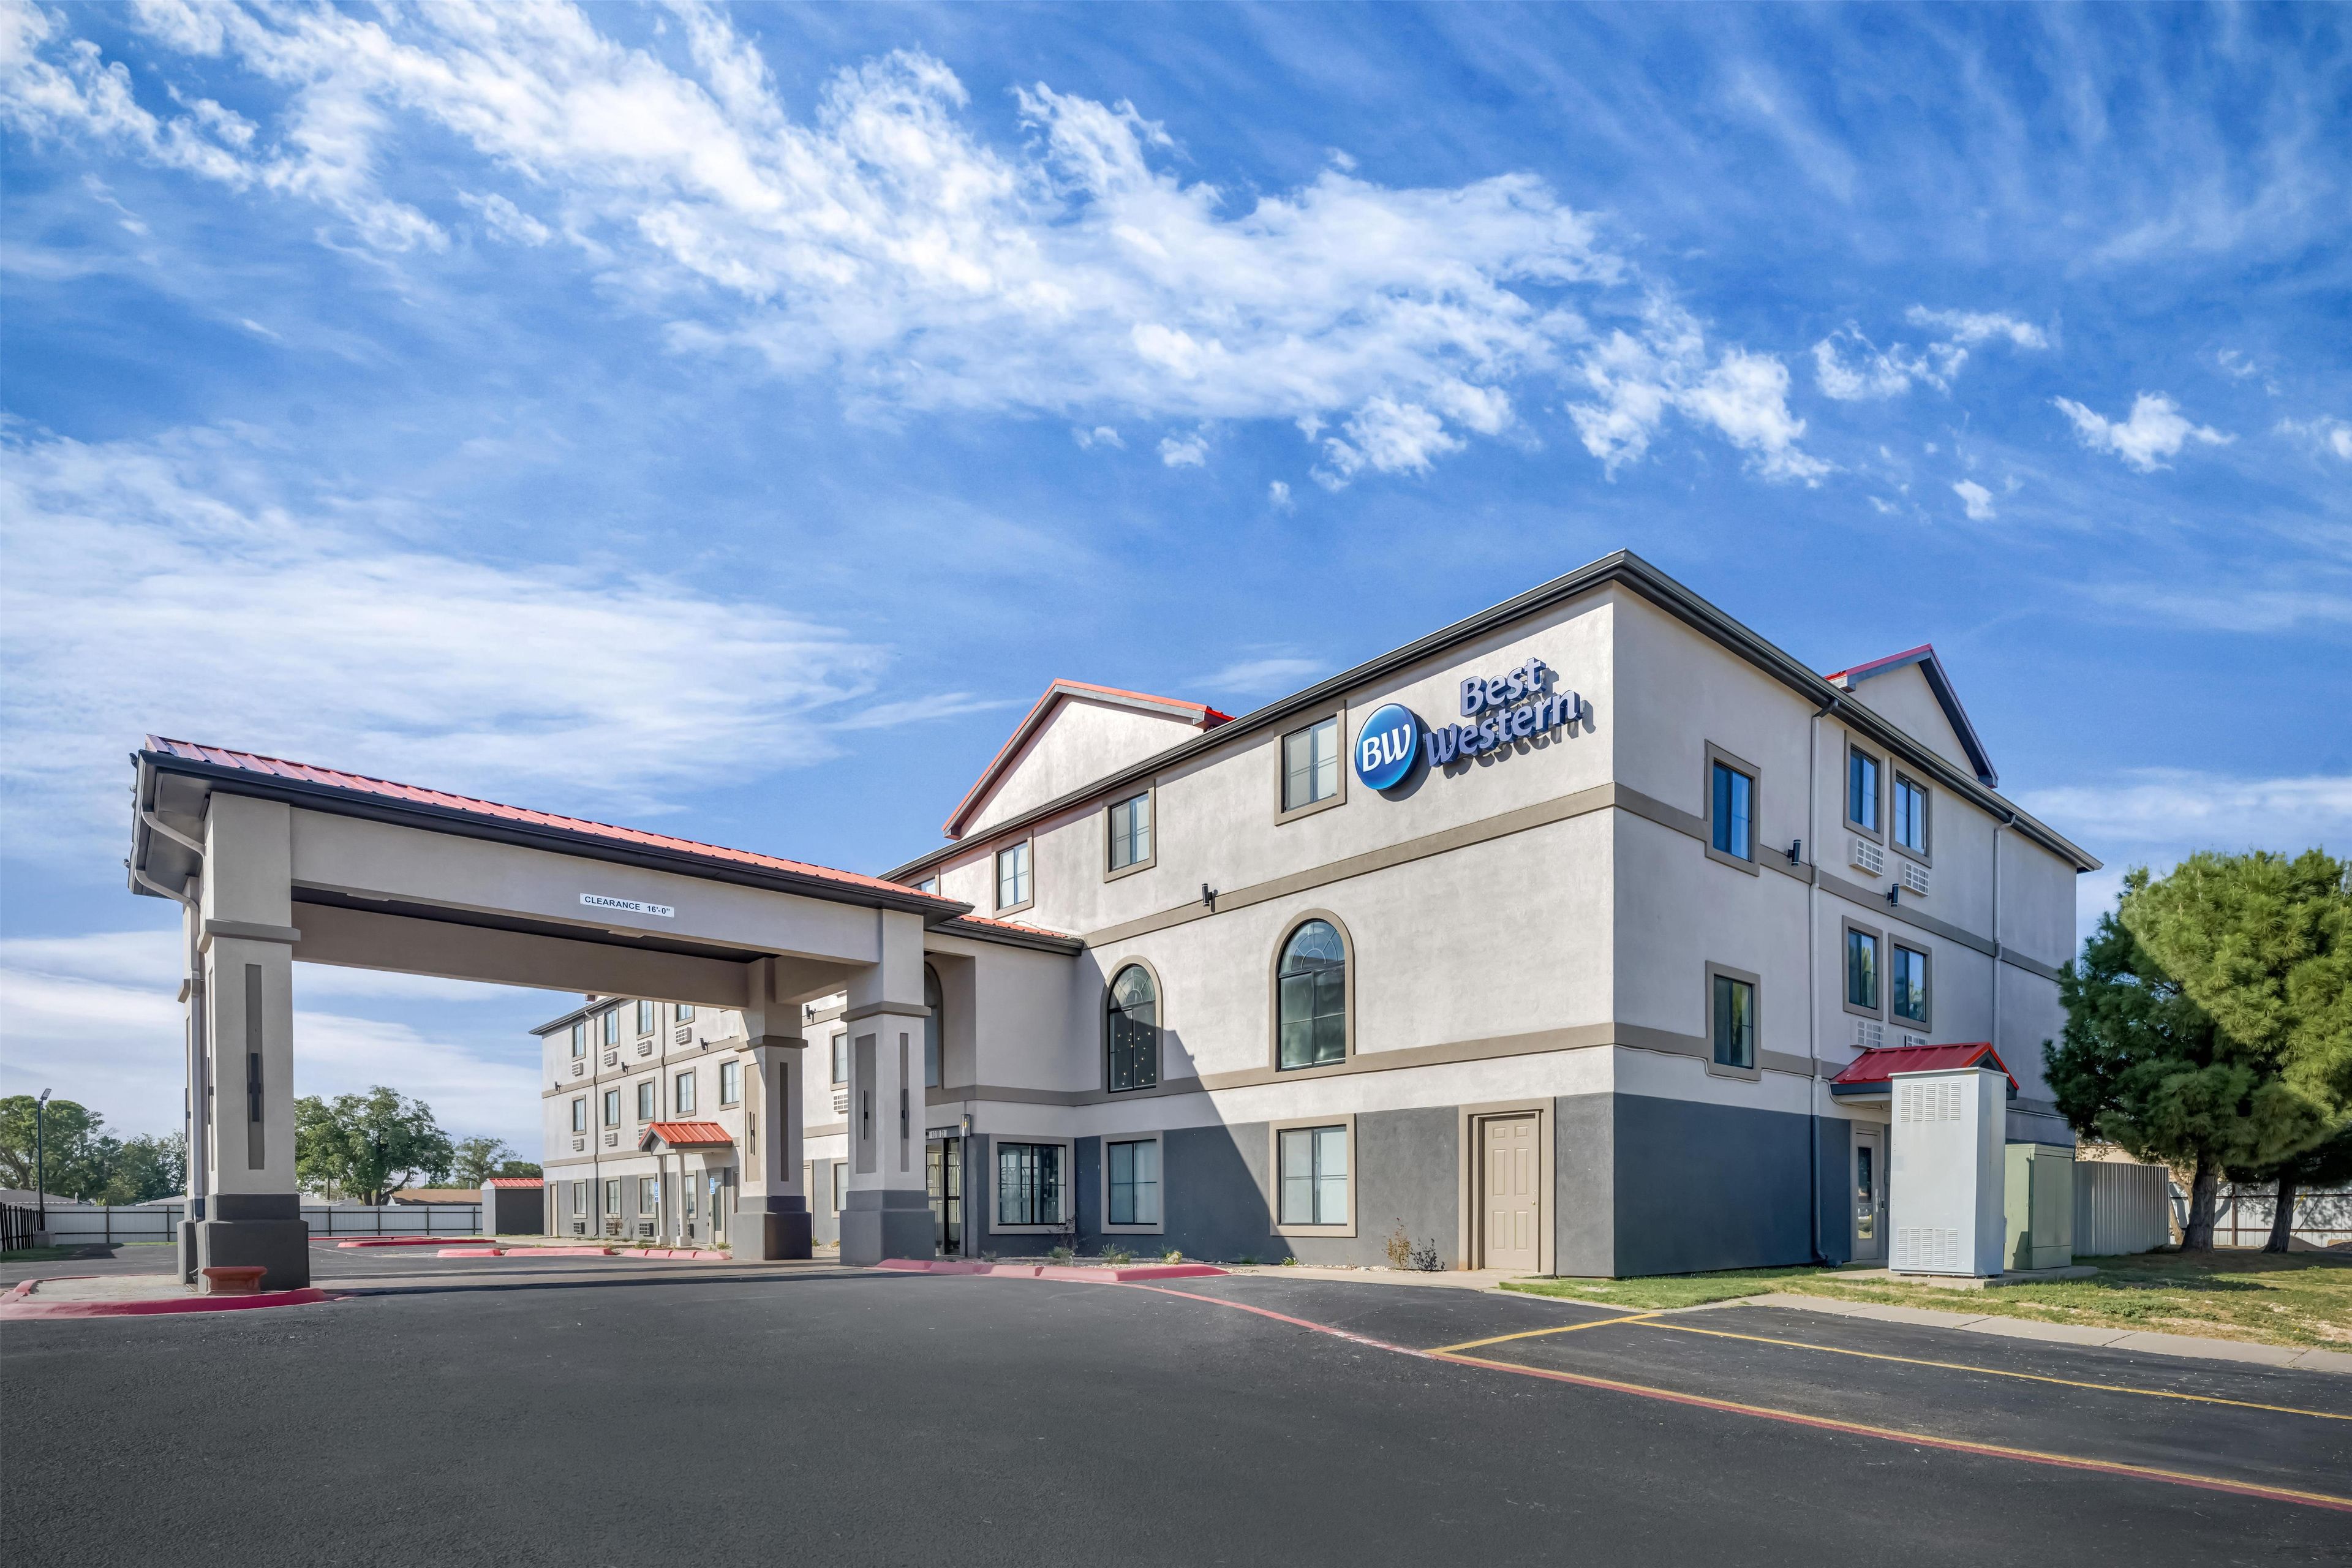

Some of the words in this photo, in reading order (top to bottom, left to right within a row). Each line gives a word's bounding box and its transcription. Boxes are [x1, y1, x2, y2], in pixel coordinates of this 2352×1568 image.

[1461, 657, 1546, 717] Best
[1362, 723, 1411, 772] BW
[1425, 690, 1582, 767] Western
[584, 896, 641, 911] CLEARANCE
